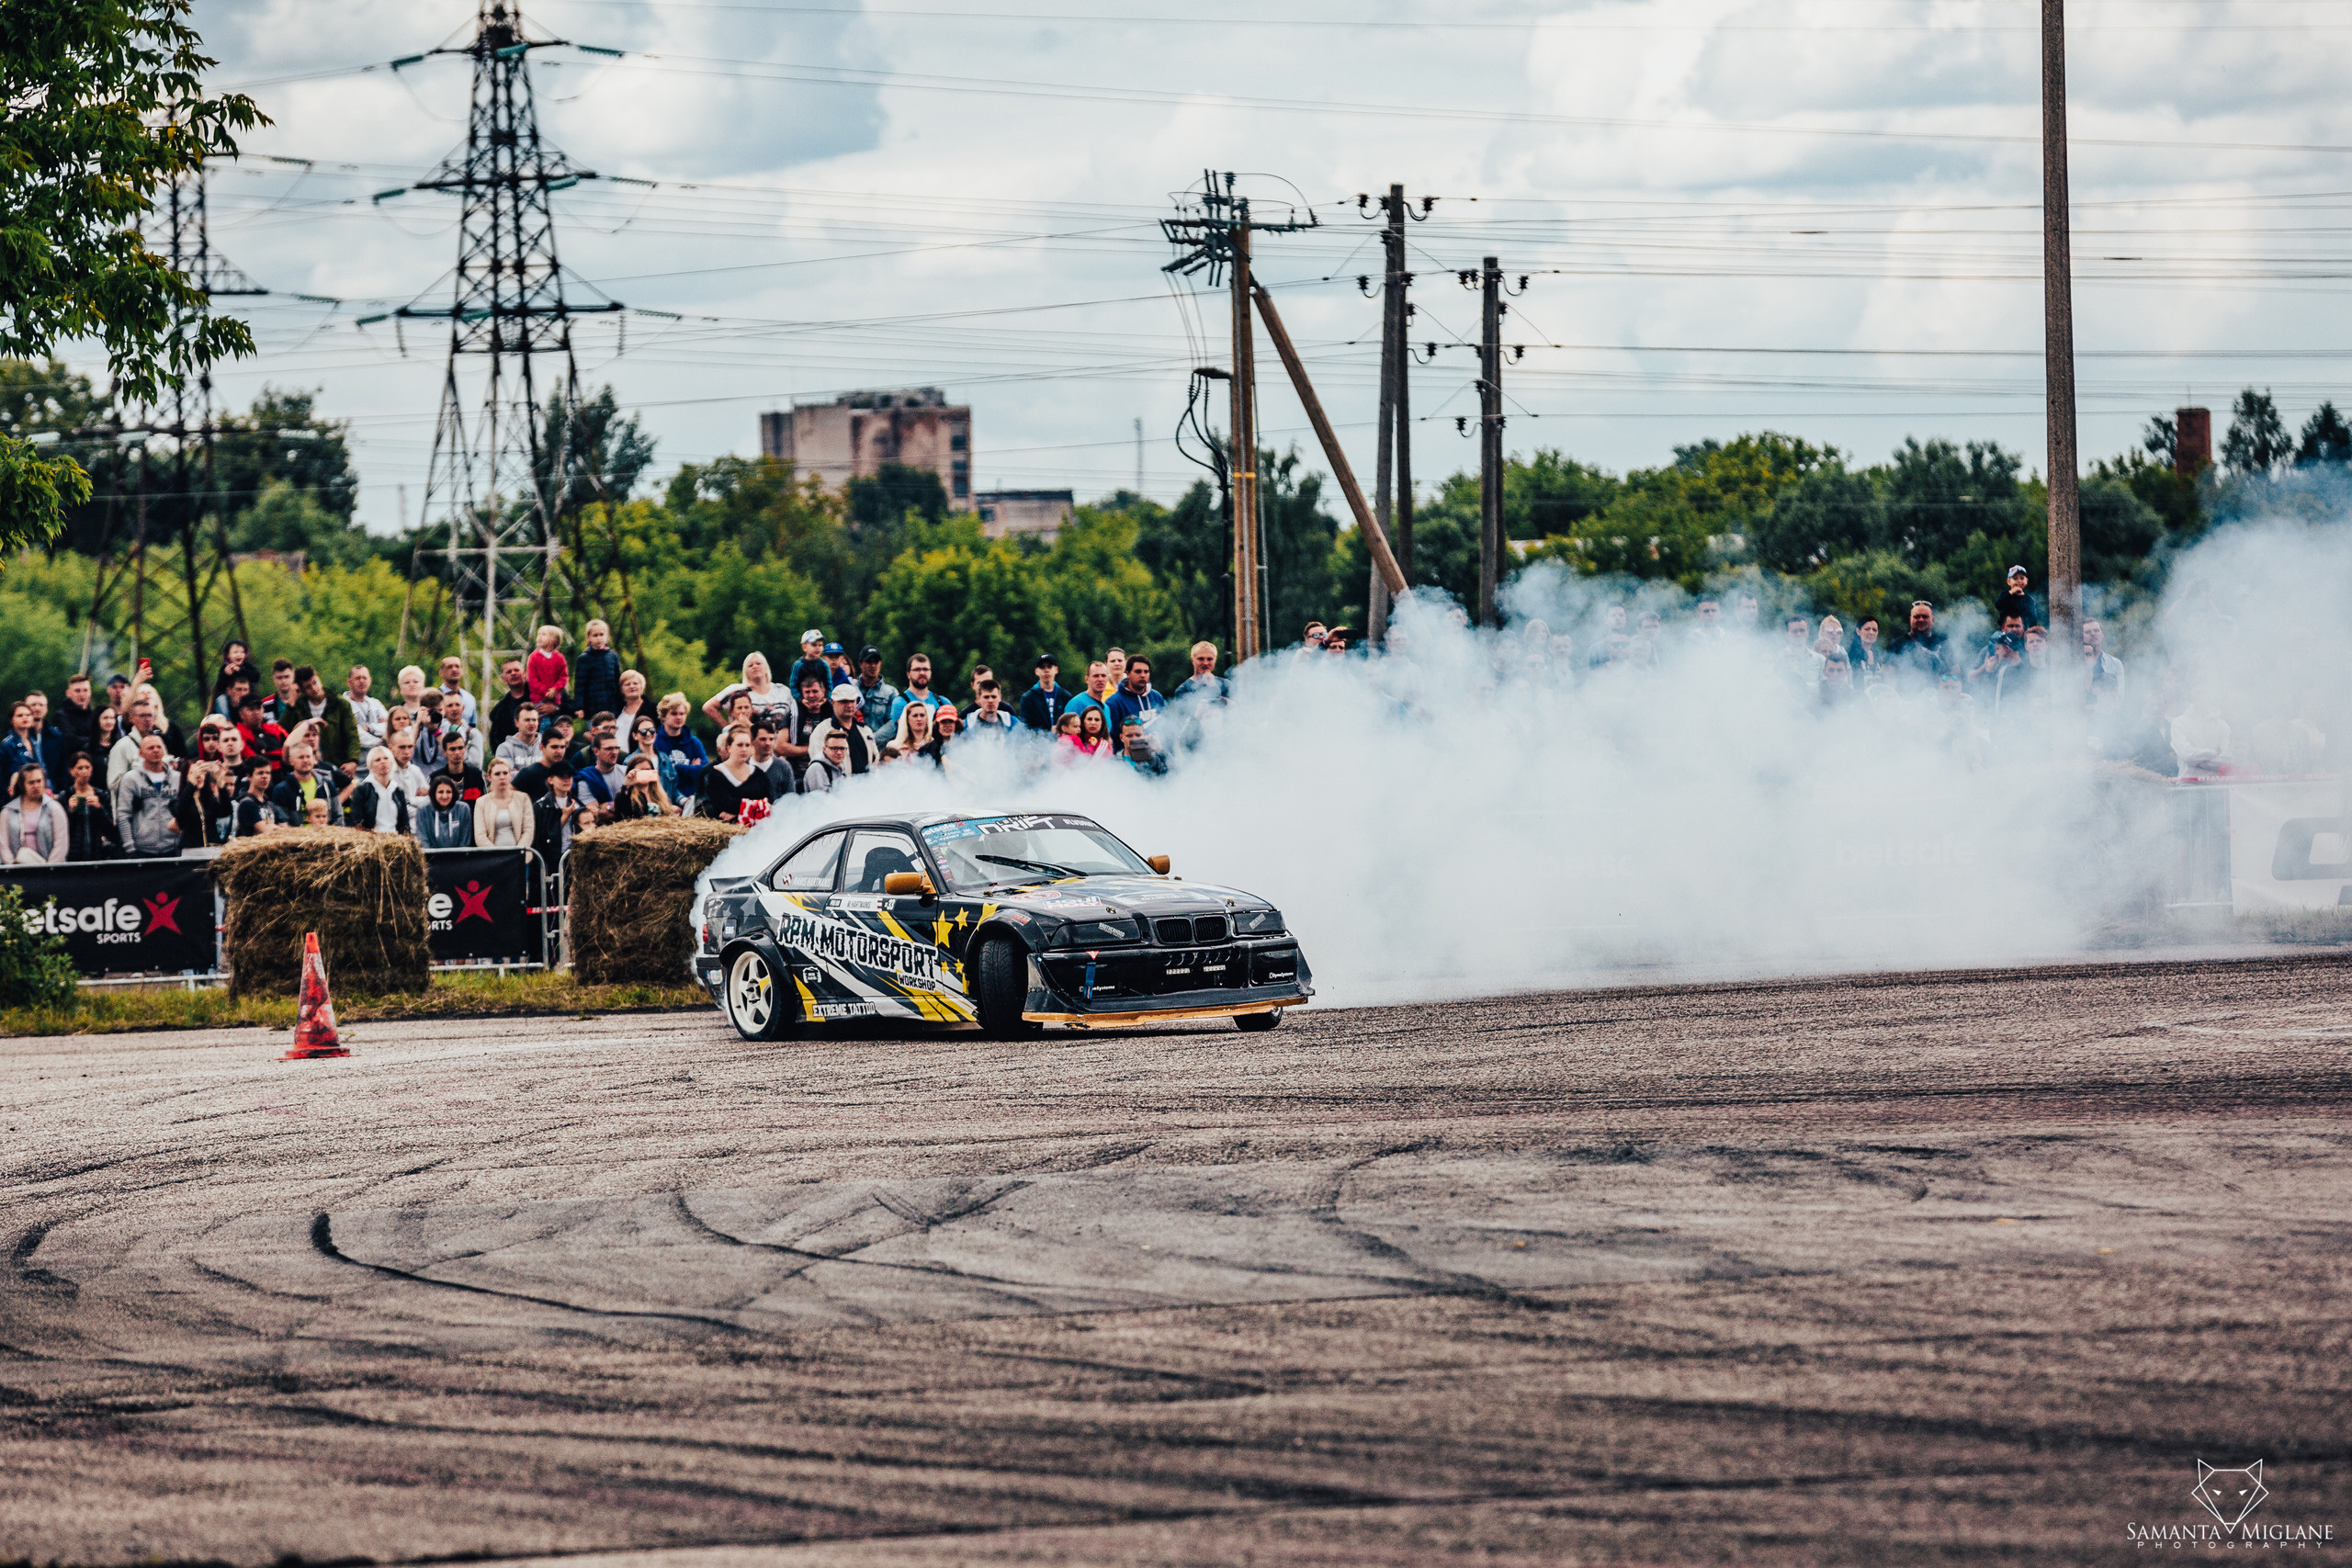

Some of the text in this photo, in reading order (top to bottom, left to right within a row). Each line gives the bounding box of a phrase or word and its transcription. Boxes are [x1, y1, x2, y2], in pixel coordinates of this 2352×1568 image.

[20, 897, 141, 934] etsafe
[96, 932, 141, 944] SPORTS
[820, 924, 938, 978] MOTORSPORT
[898, 974, 937, 992] WORKSHOP
[812, 1002, 876, 1017] EXTREME TATTOO
